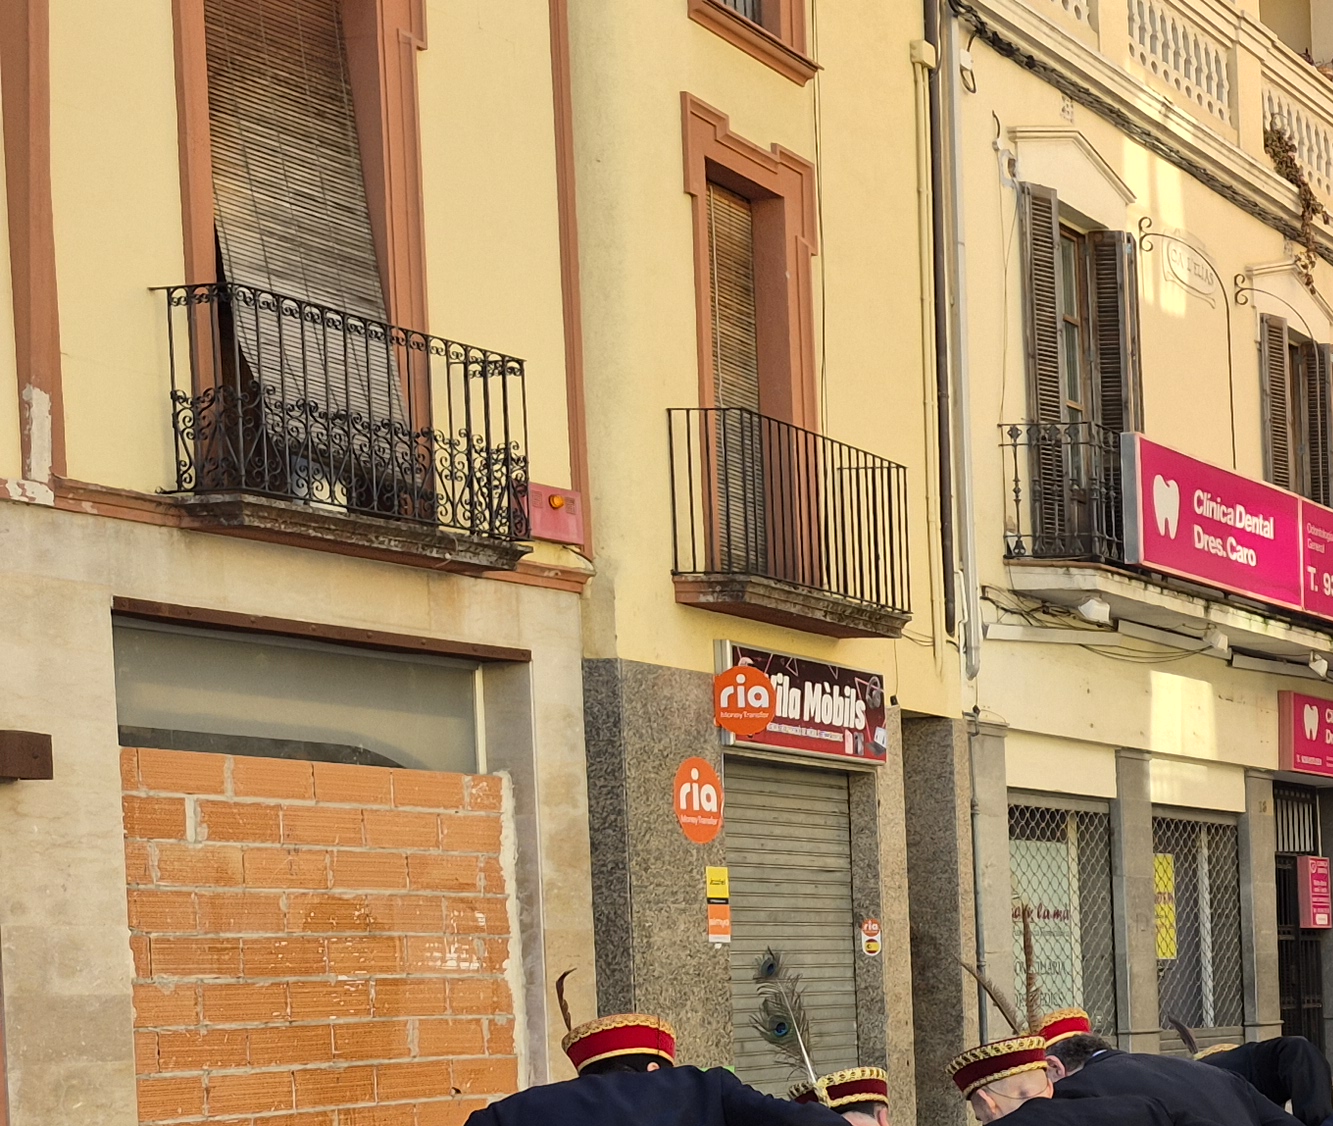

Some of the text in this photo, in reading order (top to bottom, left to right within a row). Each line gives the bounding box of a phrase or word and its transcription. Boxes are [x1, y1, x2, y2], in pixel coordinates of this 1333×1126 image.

[1193, 489, 1275, 540] Clínica Dental
[1193, 524, 1257, 567] Dres. Caro
[1306, 565, 1319, 592] T.
[719, 674, 770, 708] ria
[803, 681, 867, 731] Mòbils
[679, 768, 718, 813] ria
[863, 919, 879, 931] ria
